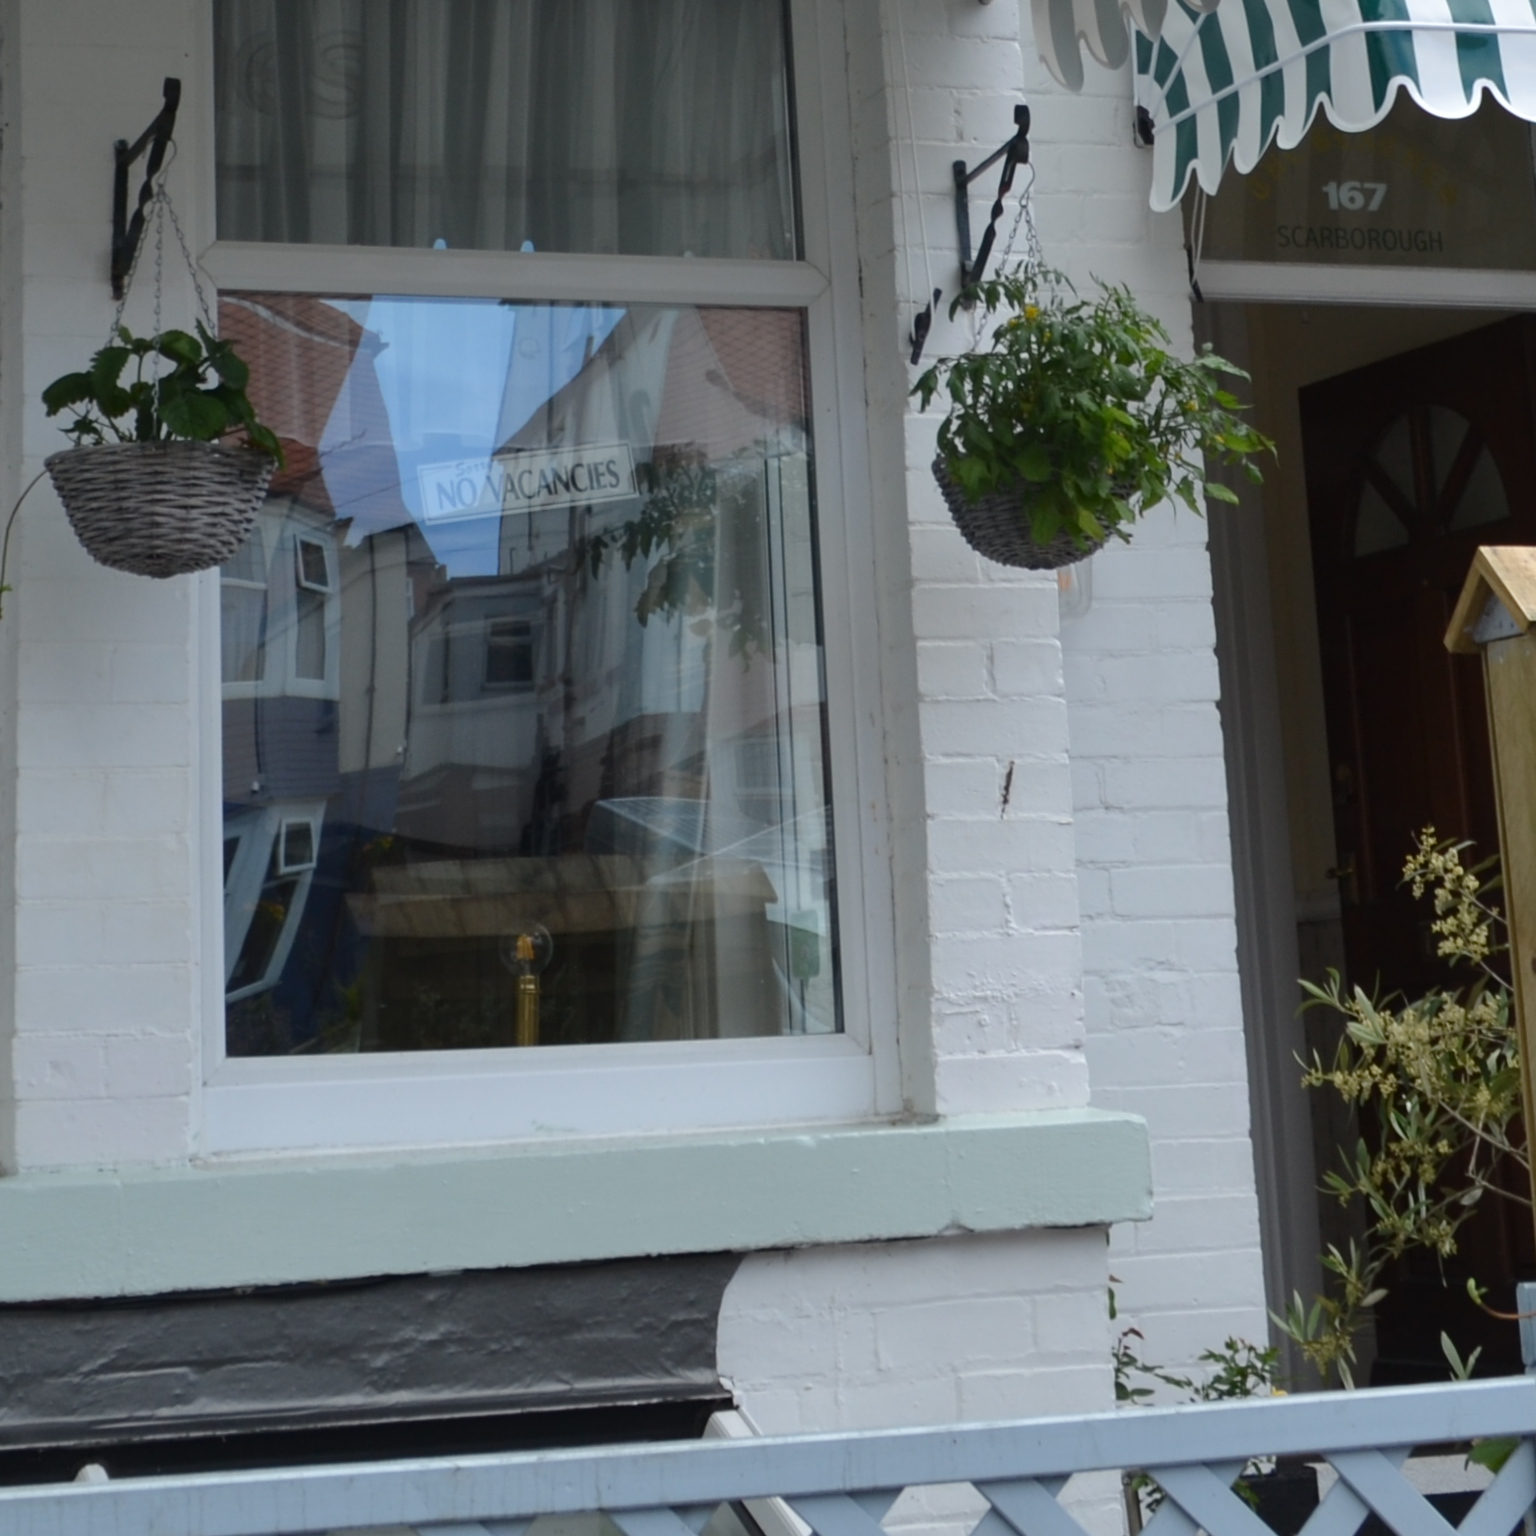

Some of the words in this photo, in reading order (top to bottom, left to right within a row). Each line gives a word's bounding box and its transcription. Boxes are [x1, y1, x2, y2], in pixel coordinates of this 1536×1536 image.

[1321, 180, 1389, 213] 167
[1277, 224, 1444, 253] SCARBOROUGH
[435, 476, 478, 510] NO
[485, 458, 621, 503] VACANCIES
